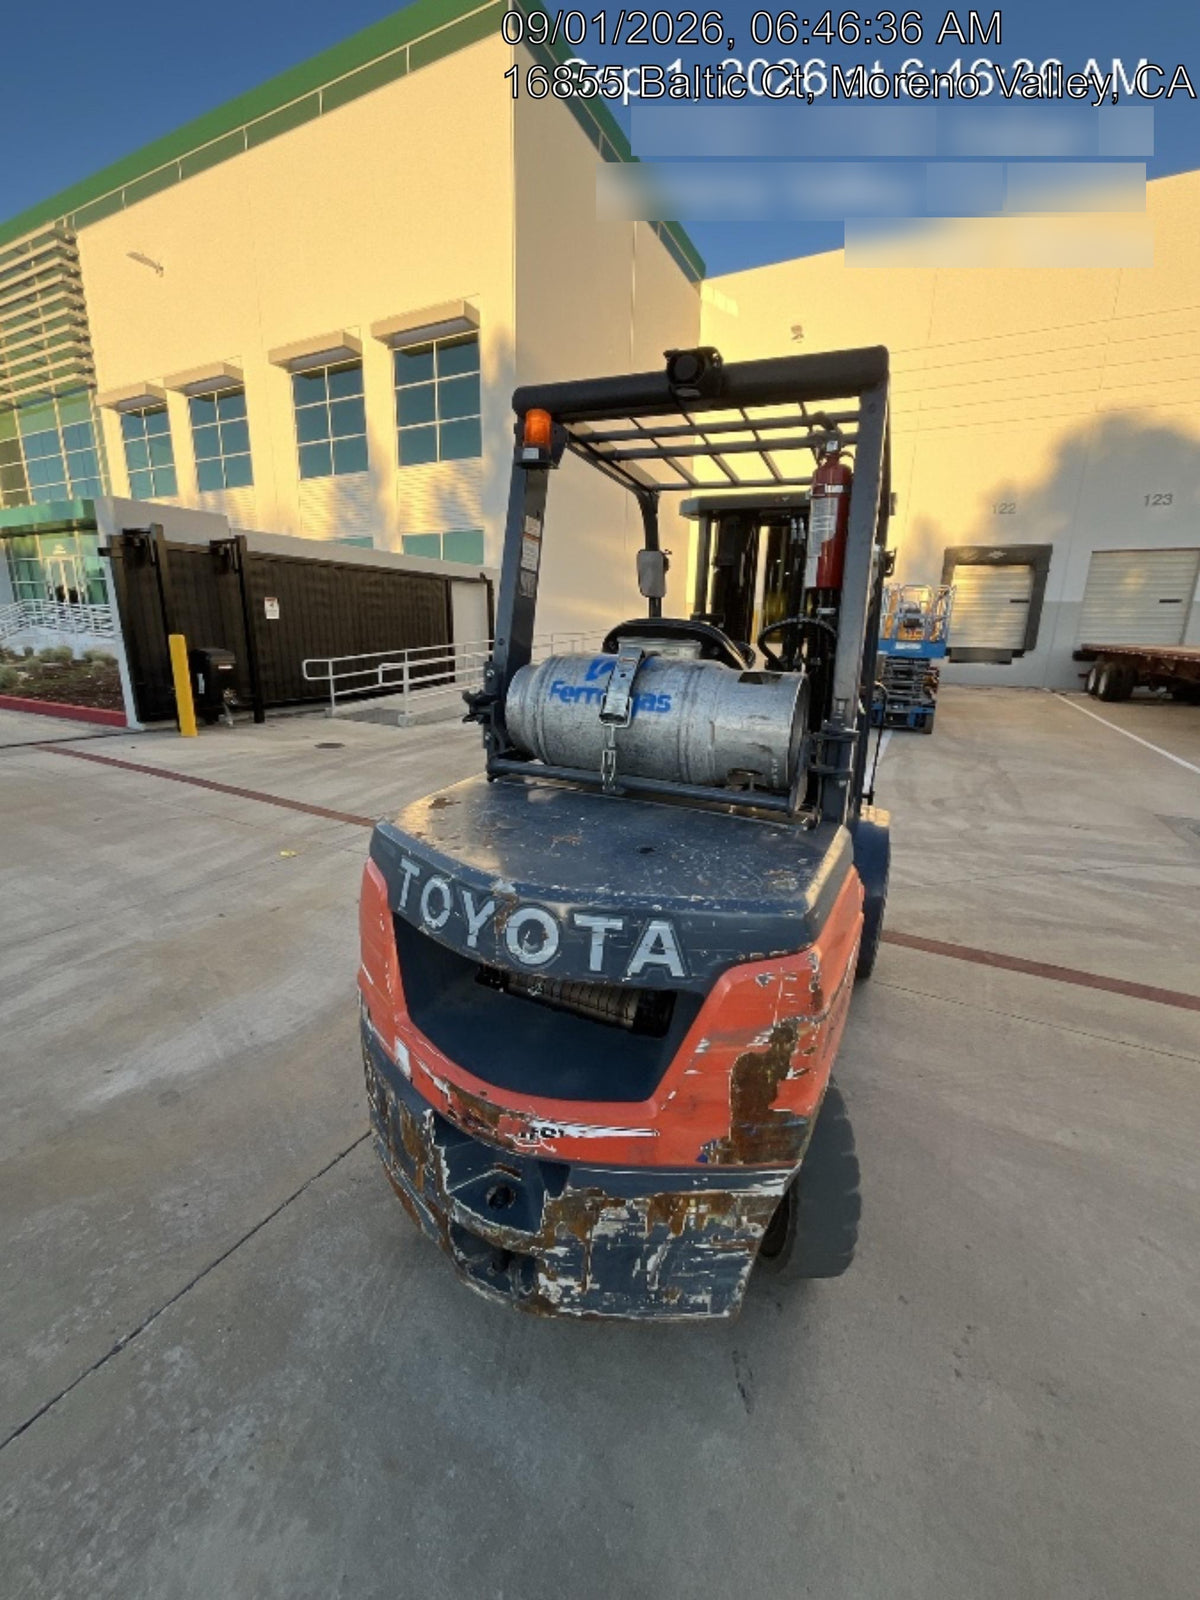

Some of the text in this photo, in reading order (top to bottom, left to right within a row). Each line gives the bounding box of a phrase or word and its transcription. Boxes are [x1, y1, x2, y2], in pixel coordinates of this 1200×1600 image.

[1144, 493, 1173, 507] 123
[992, 502, 1017, 515] 122
[398, 857, 687, 979] TOYOTA
